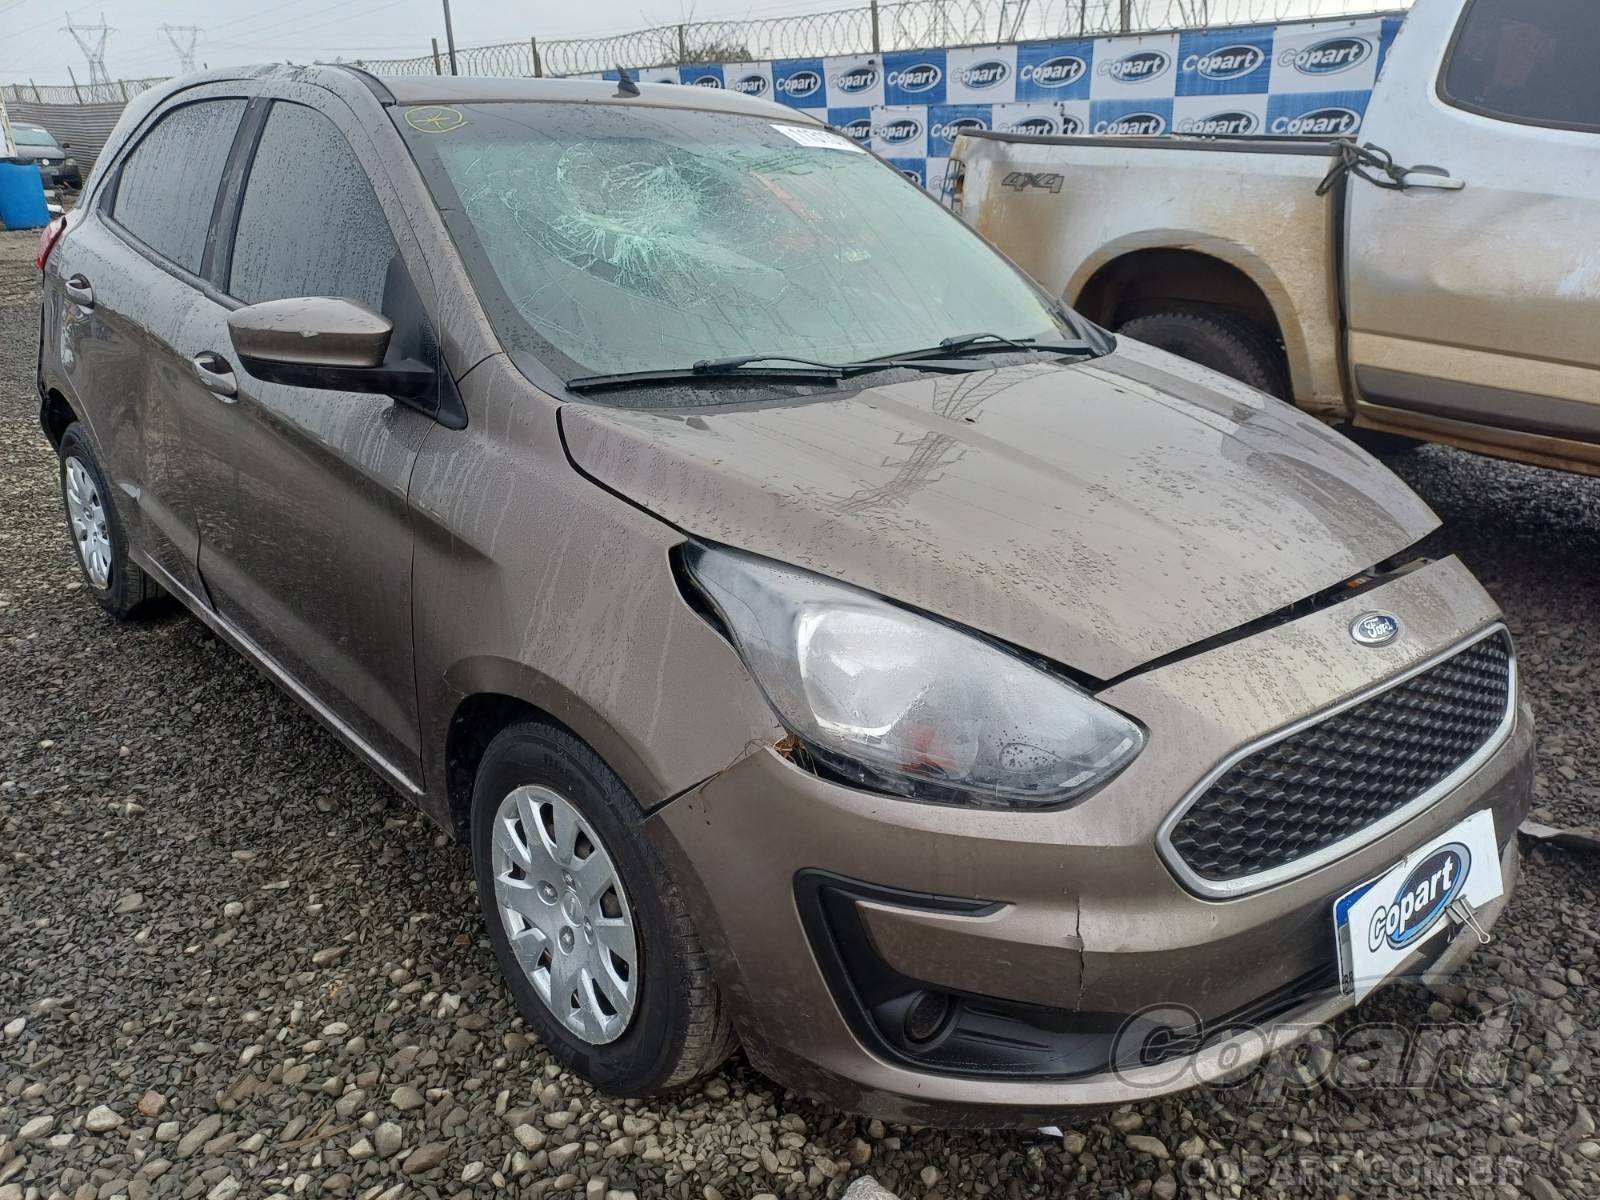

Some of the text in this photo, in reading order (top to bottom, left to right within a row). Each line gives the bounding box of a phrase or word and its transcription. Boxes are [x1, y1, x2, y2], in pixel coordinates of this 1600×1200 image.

[1097, 56, 1163, 82] Copart
[1182, 51, 1256, 79] Copart
[1277, 44, 1362, 73] Copart
[776, 74, 817, 96] Copart
[831, 71, 873, 94] Copart
[887, 68, 938, 91] Copart
[952, 65, 1005, 90] Copart
[1020, 62, 1081, 87] Copart
[871, 123, 916, 142] Copart
[1094, 120, 1156, 135] Copart
[1178, 117, 1248, 134] Copart
[1271, 113, 1349, 134] Copart
[1364, 617, 1393, 637] Ford
[1367, 855, 1454, 953] Copart
